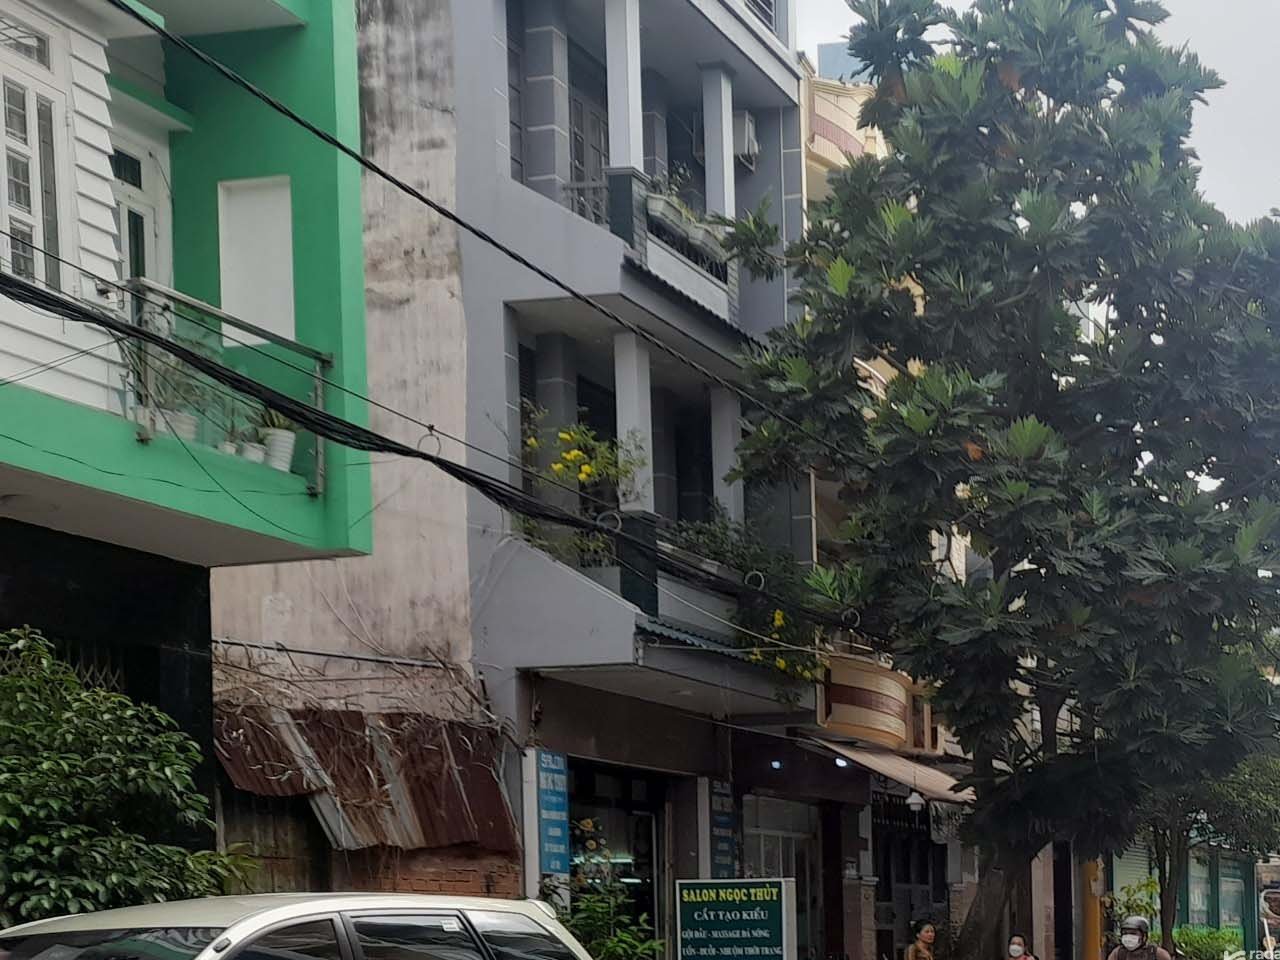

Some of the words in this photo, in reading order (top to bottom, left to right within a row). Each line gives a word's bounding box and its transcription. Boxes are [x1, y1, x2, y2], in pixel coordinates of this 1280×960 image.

[682, 888, 717, 902] SALON
[718, 888, 748, 904] NGỌC
[718, 910, 741, 922] TẠO
